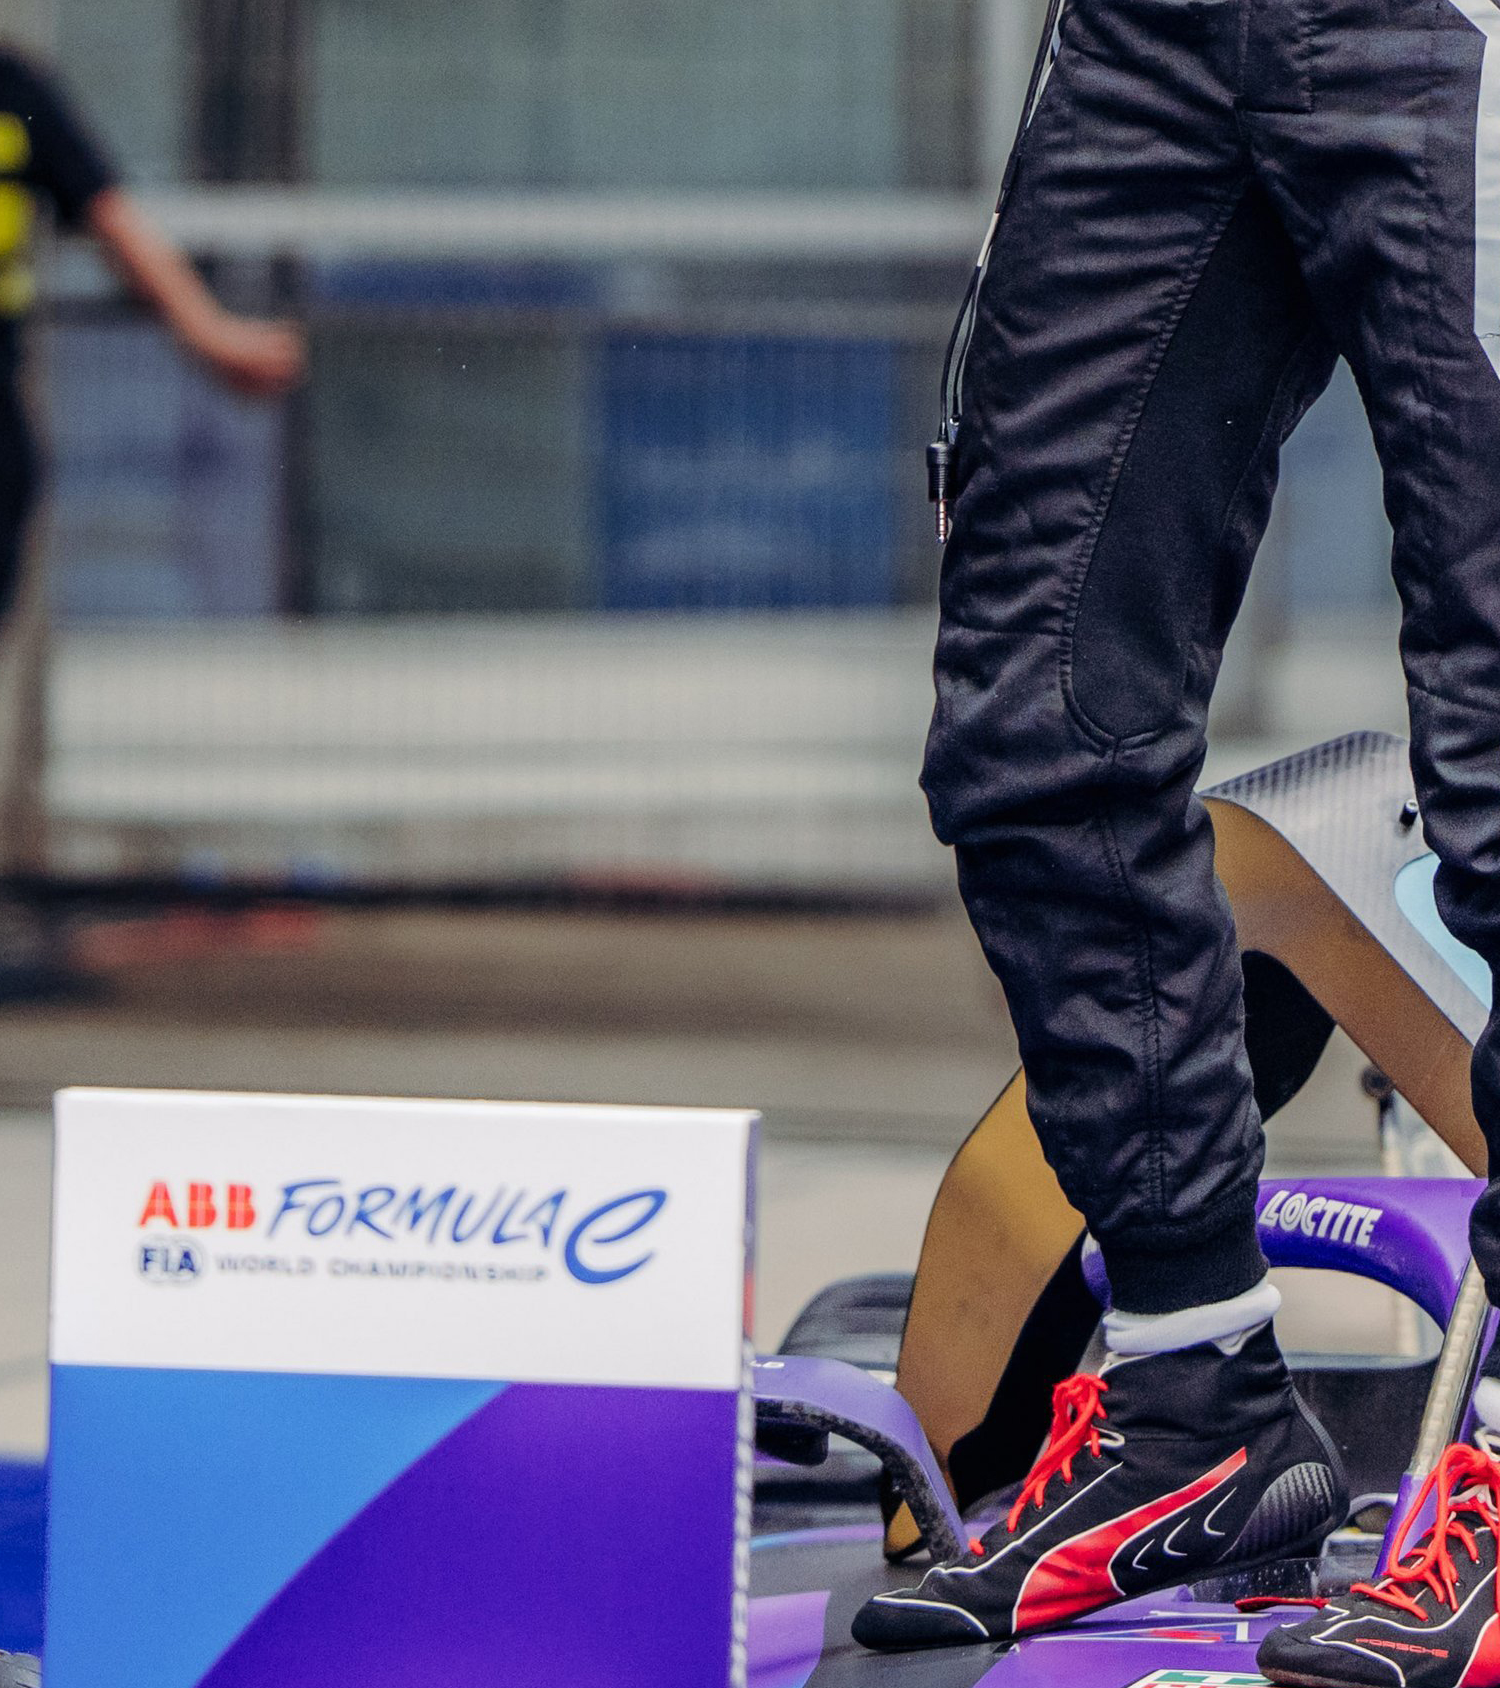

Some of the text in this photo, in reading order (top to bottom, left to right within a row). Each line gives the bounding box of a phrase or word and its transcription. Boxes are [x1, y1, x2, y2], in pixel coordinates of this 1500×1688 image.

[139, 1181, 256, 1230] ABB
[266, 1178, 567, 1250] FORMULA
[1258, 1189, 1384, 1248] LOCTITE
[140, 1245, 550, 1283] FIA WORLD CHAMPIONSHIP
[1355, 1637, 1449, 1659] PORSCHE
